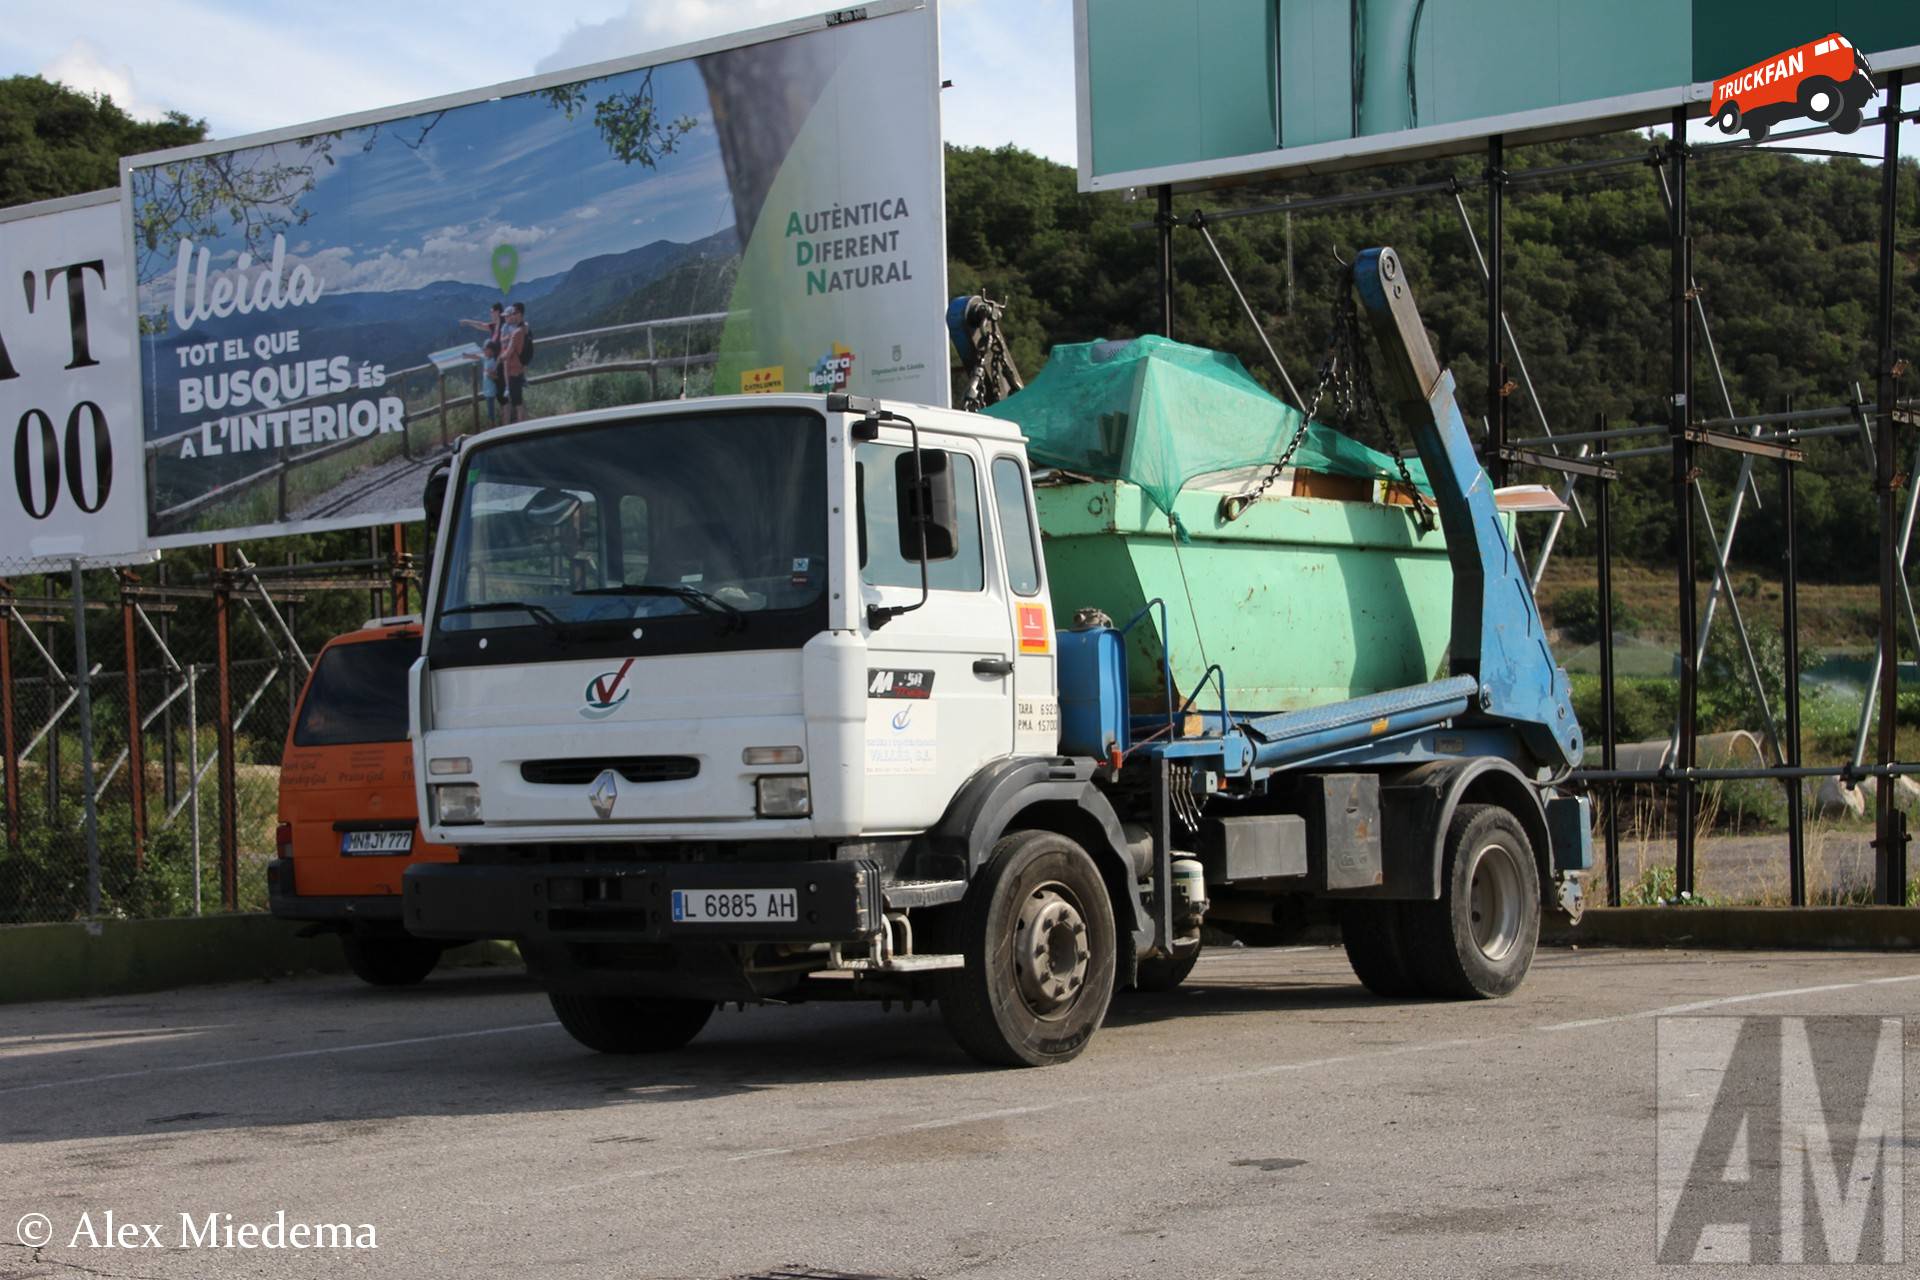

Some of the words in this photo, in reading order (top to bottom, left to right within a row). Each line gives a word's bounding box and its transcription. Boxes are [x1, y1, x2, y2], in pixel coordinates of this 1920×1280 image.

[785, 197, 909, 238] AUTÈNTICA
[796, 230, 900, 267] DIFERENT
[806, 260, 913, 296] NATURAL
[176, 342, 219, 368] TOT
[223, 338, 250, 361] EL
[254, 330, 300, 360] QUE
[826, 356, 850, 370] ara
[179, 355, 352, 414] BUSQUES
[809, 371, 844, 386] lleida
[13, 400, 113, 520] 00
[179, 438, 197, 459] A
[1018, 703, 1033, 714] TARA
[1018, 719, 1033, 731] PMA
[389, 832, 410, 849] 777
[685, 893, 697, 918] L
[704, 893, 757, 918] 6885
[767, 893, 796, 918] AH
